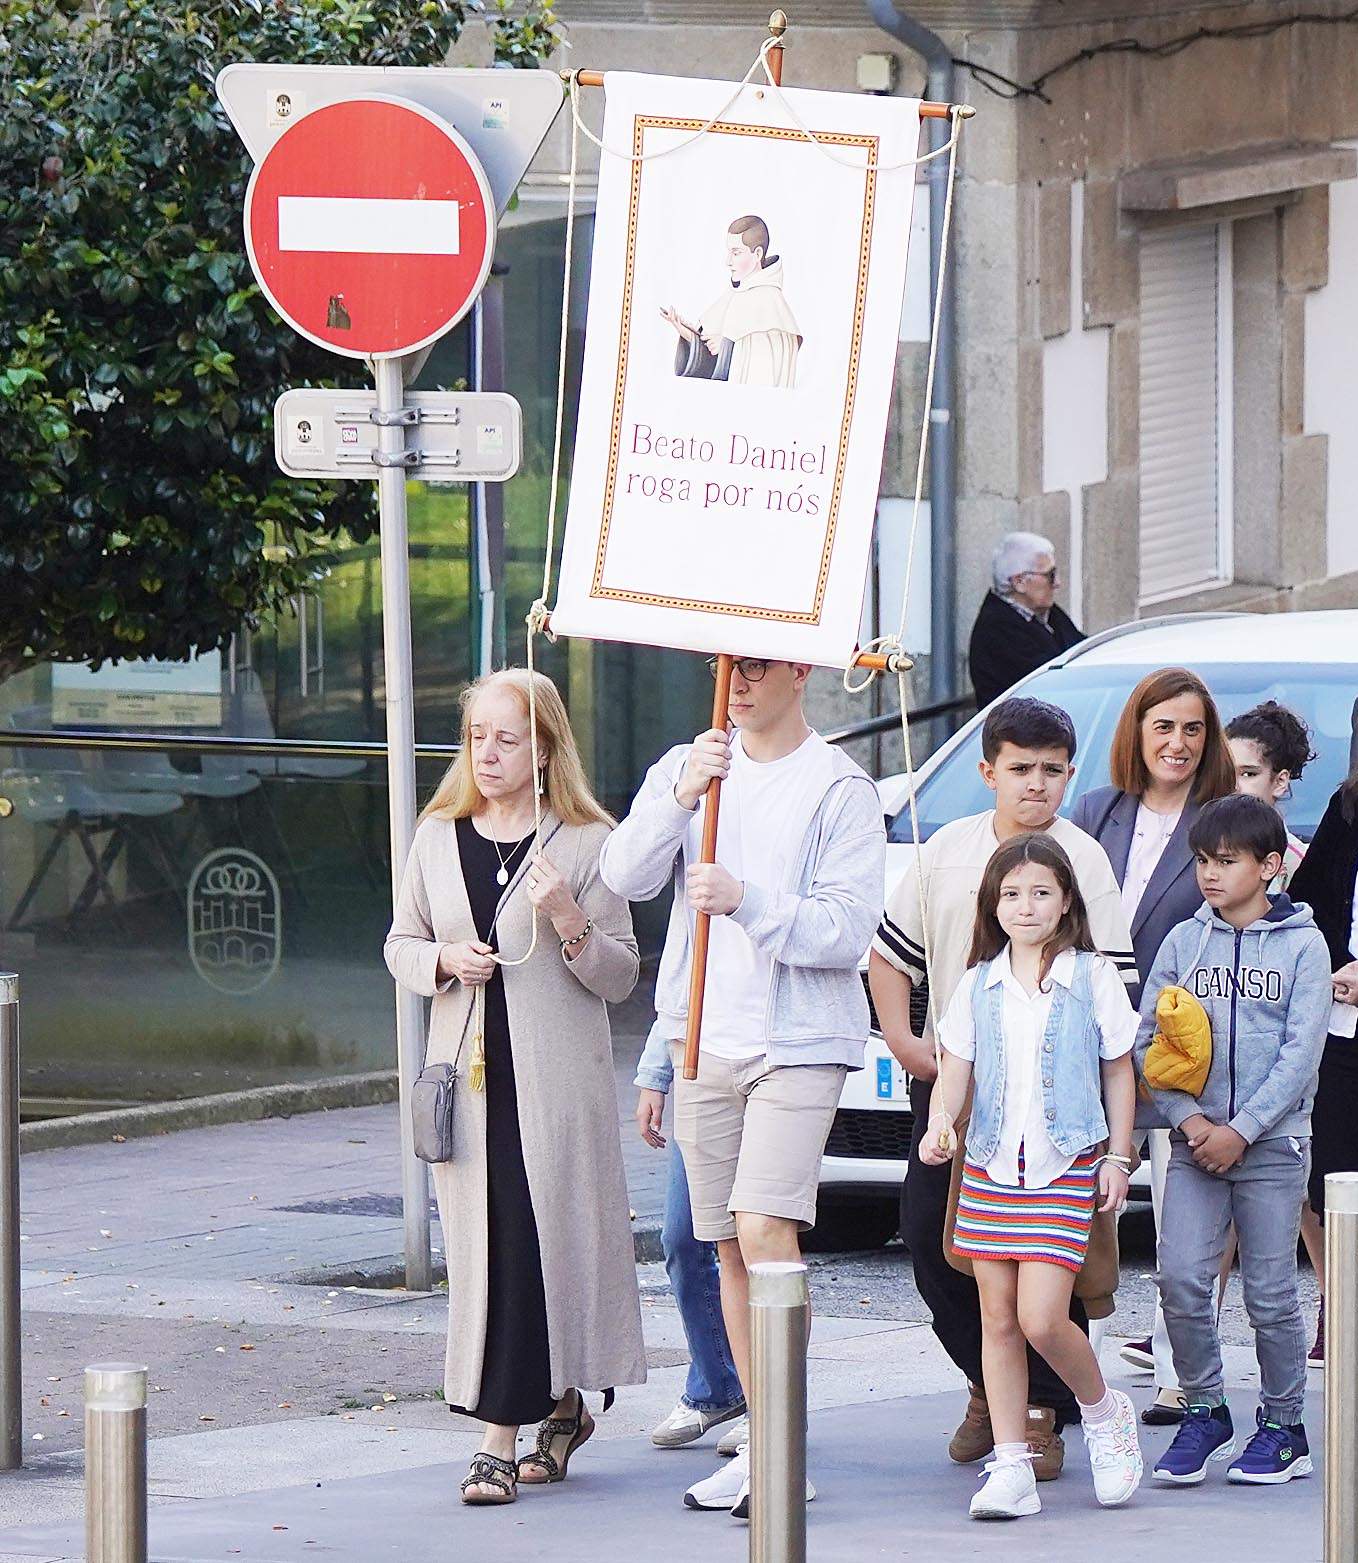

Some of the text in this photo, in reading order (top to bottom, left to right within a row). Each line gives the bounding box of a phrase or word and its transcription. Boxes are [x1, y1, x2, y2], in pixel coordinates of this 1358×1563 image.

[631, 424, 826, 475] Beato Daniel
[626, 473, 820, 516] roga por nós
[1194, 966, 1283, 1003] GANSO
[881, 1082, 889, 1092] E
